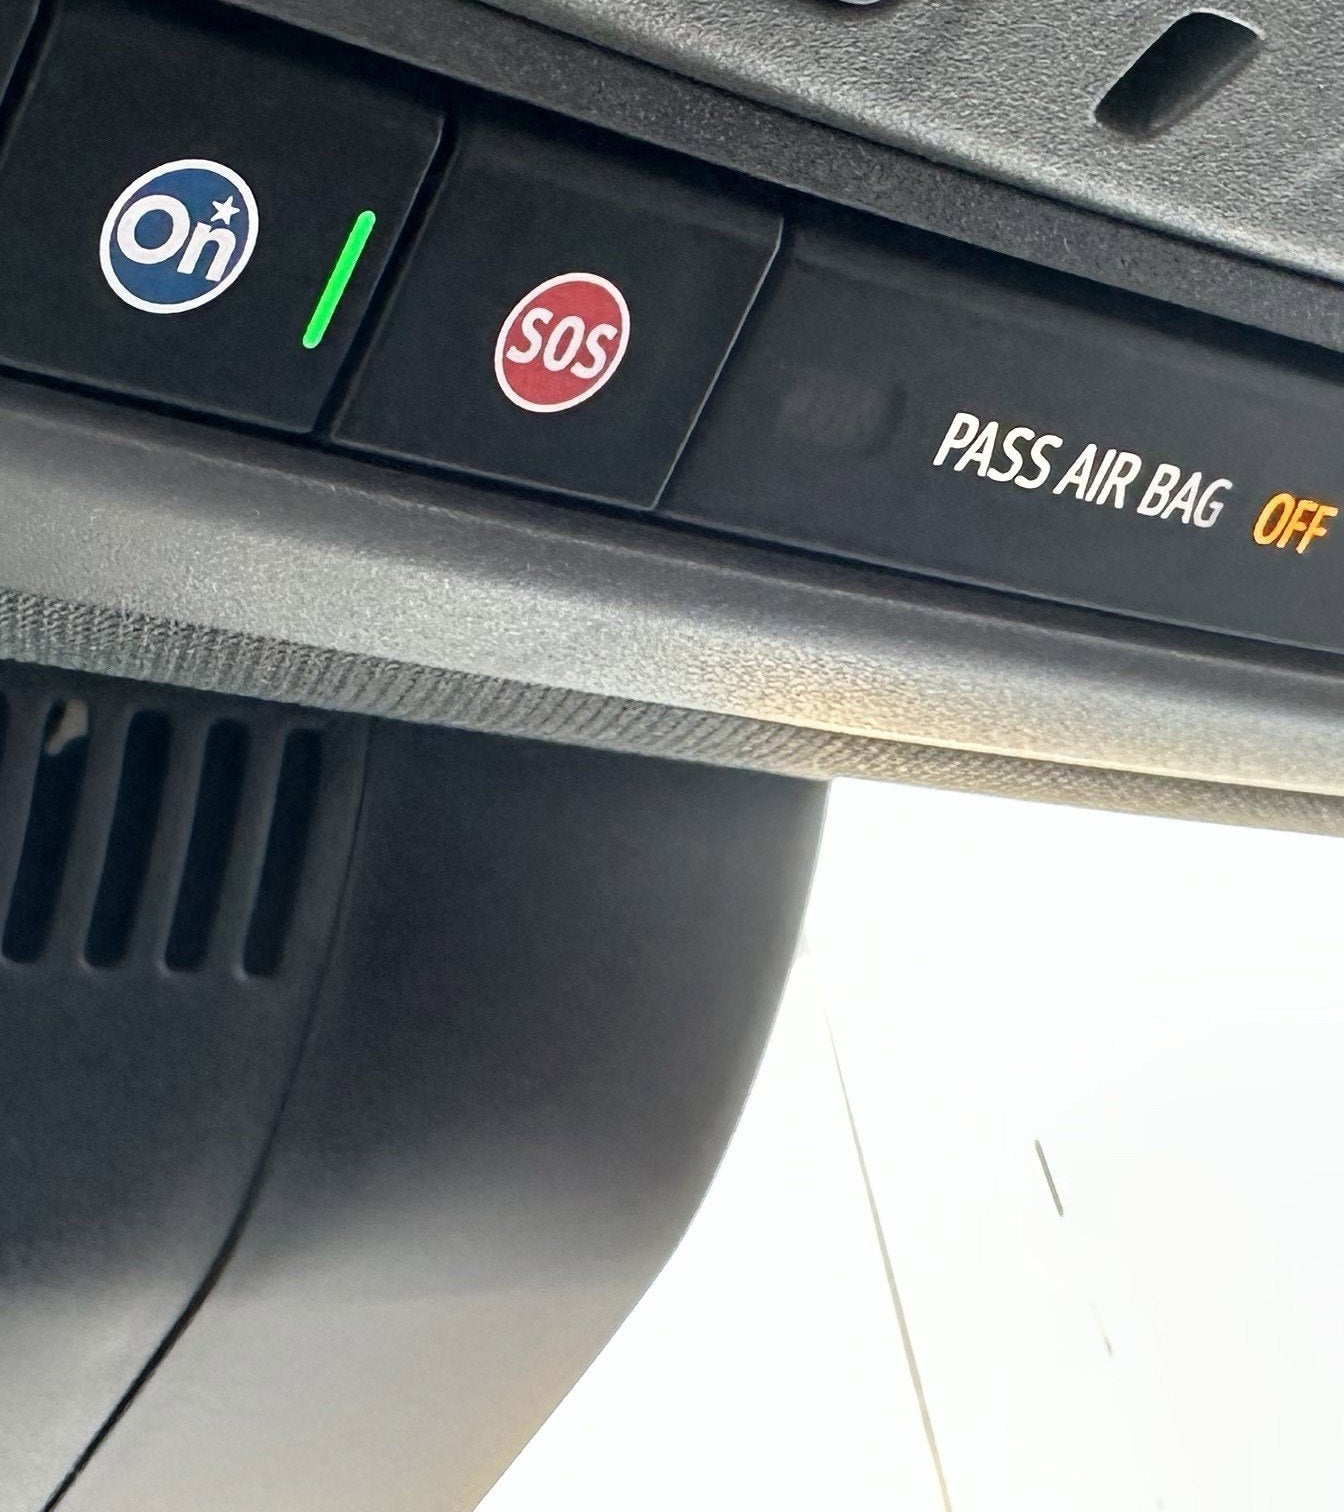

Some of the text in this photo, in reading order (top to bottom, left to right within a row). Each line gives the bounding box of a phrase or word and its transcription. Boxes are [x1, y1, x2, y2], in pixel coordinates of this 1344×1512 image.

[116, 194, 237, 282] On
[506, 307, 618, 379] SOS
[933, 412, 1339, 554] PASS AIR BAG OFF
